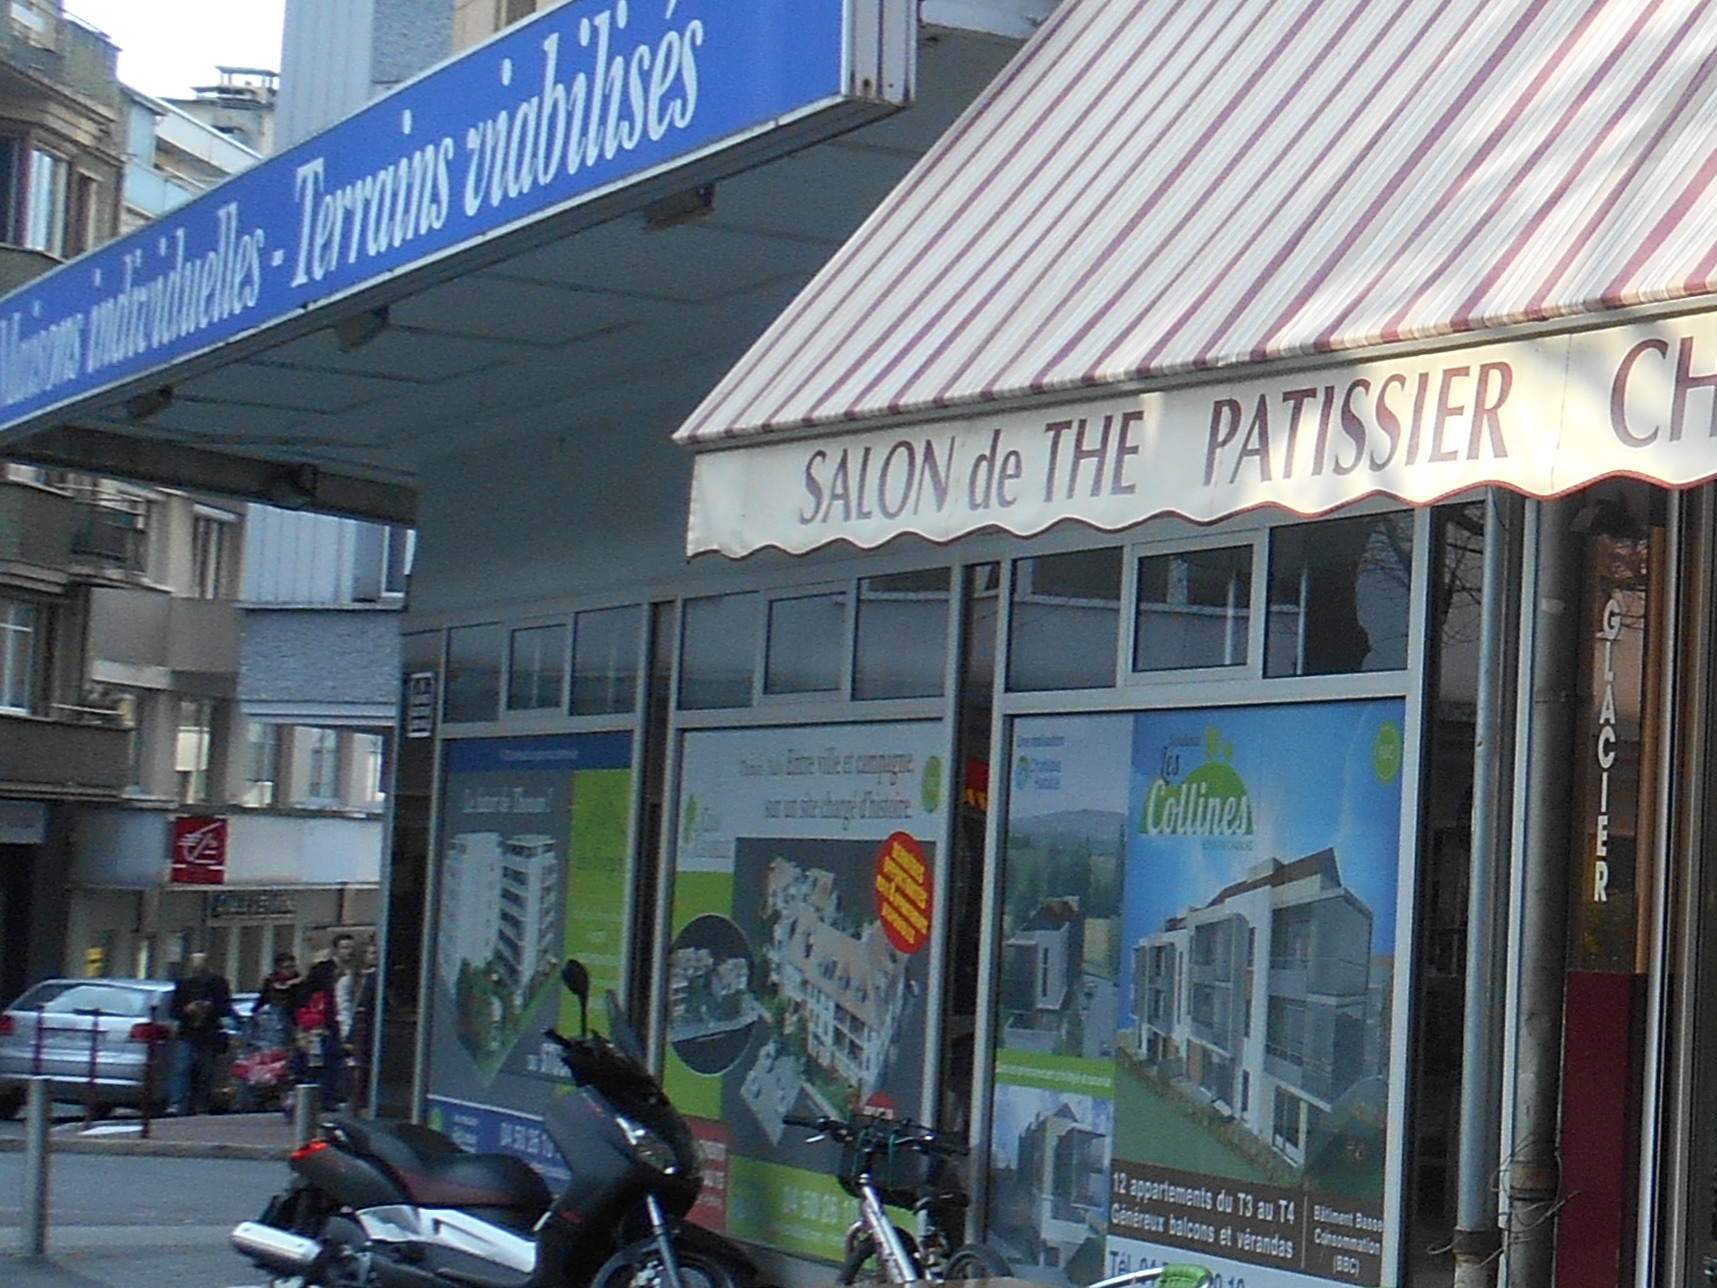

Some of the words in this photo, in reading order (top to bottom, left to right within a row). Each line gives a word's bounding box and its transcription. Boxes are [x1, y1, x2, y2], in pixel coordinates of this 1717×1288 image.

[87, 202, 265, 373] individuelles
[290, 109, 454, 290] Terrains
[798, 437, 956, 526] SALON
[968, 429, 1022, 509] de
[1042, 411, 1146, 503] THE
[1203, 360, 1513, 487] PATISSIER
[1593, 598, 1622, 902] GLACIER
[1147, 778, 1248, 836] Collines
[1113, 1172, 1127, 1194] 12
[1130, 1179, 1213, 1209] appartements
[1216, 1189, 1233, 1213] du
[1237, 1192, 1253, 1217] T3
[1257, 1200, 1275, 1221] au
[1278, 1199, 1295, 1224] T4
[1111, 1203, 1165, 1233] Généreux
[1169, 1214, 1216, 1243] balcons
[1220, 1226, 1232, 1246] et
[1237, 1228, 1294, 1258] vérandas
[1314, 1228, 1381, 1254] Consommation
